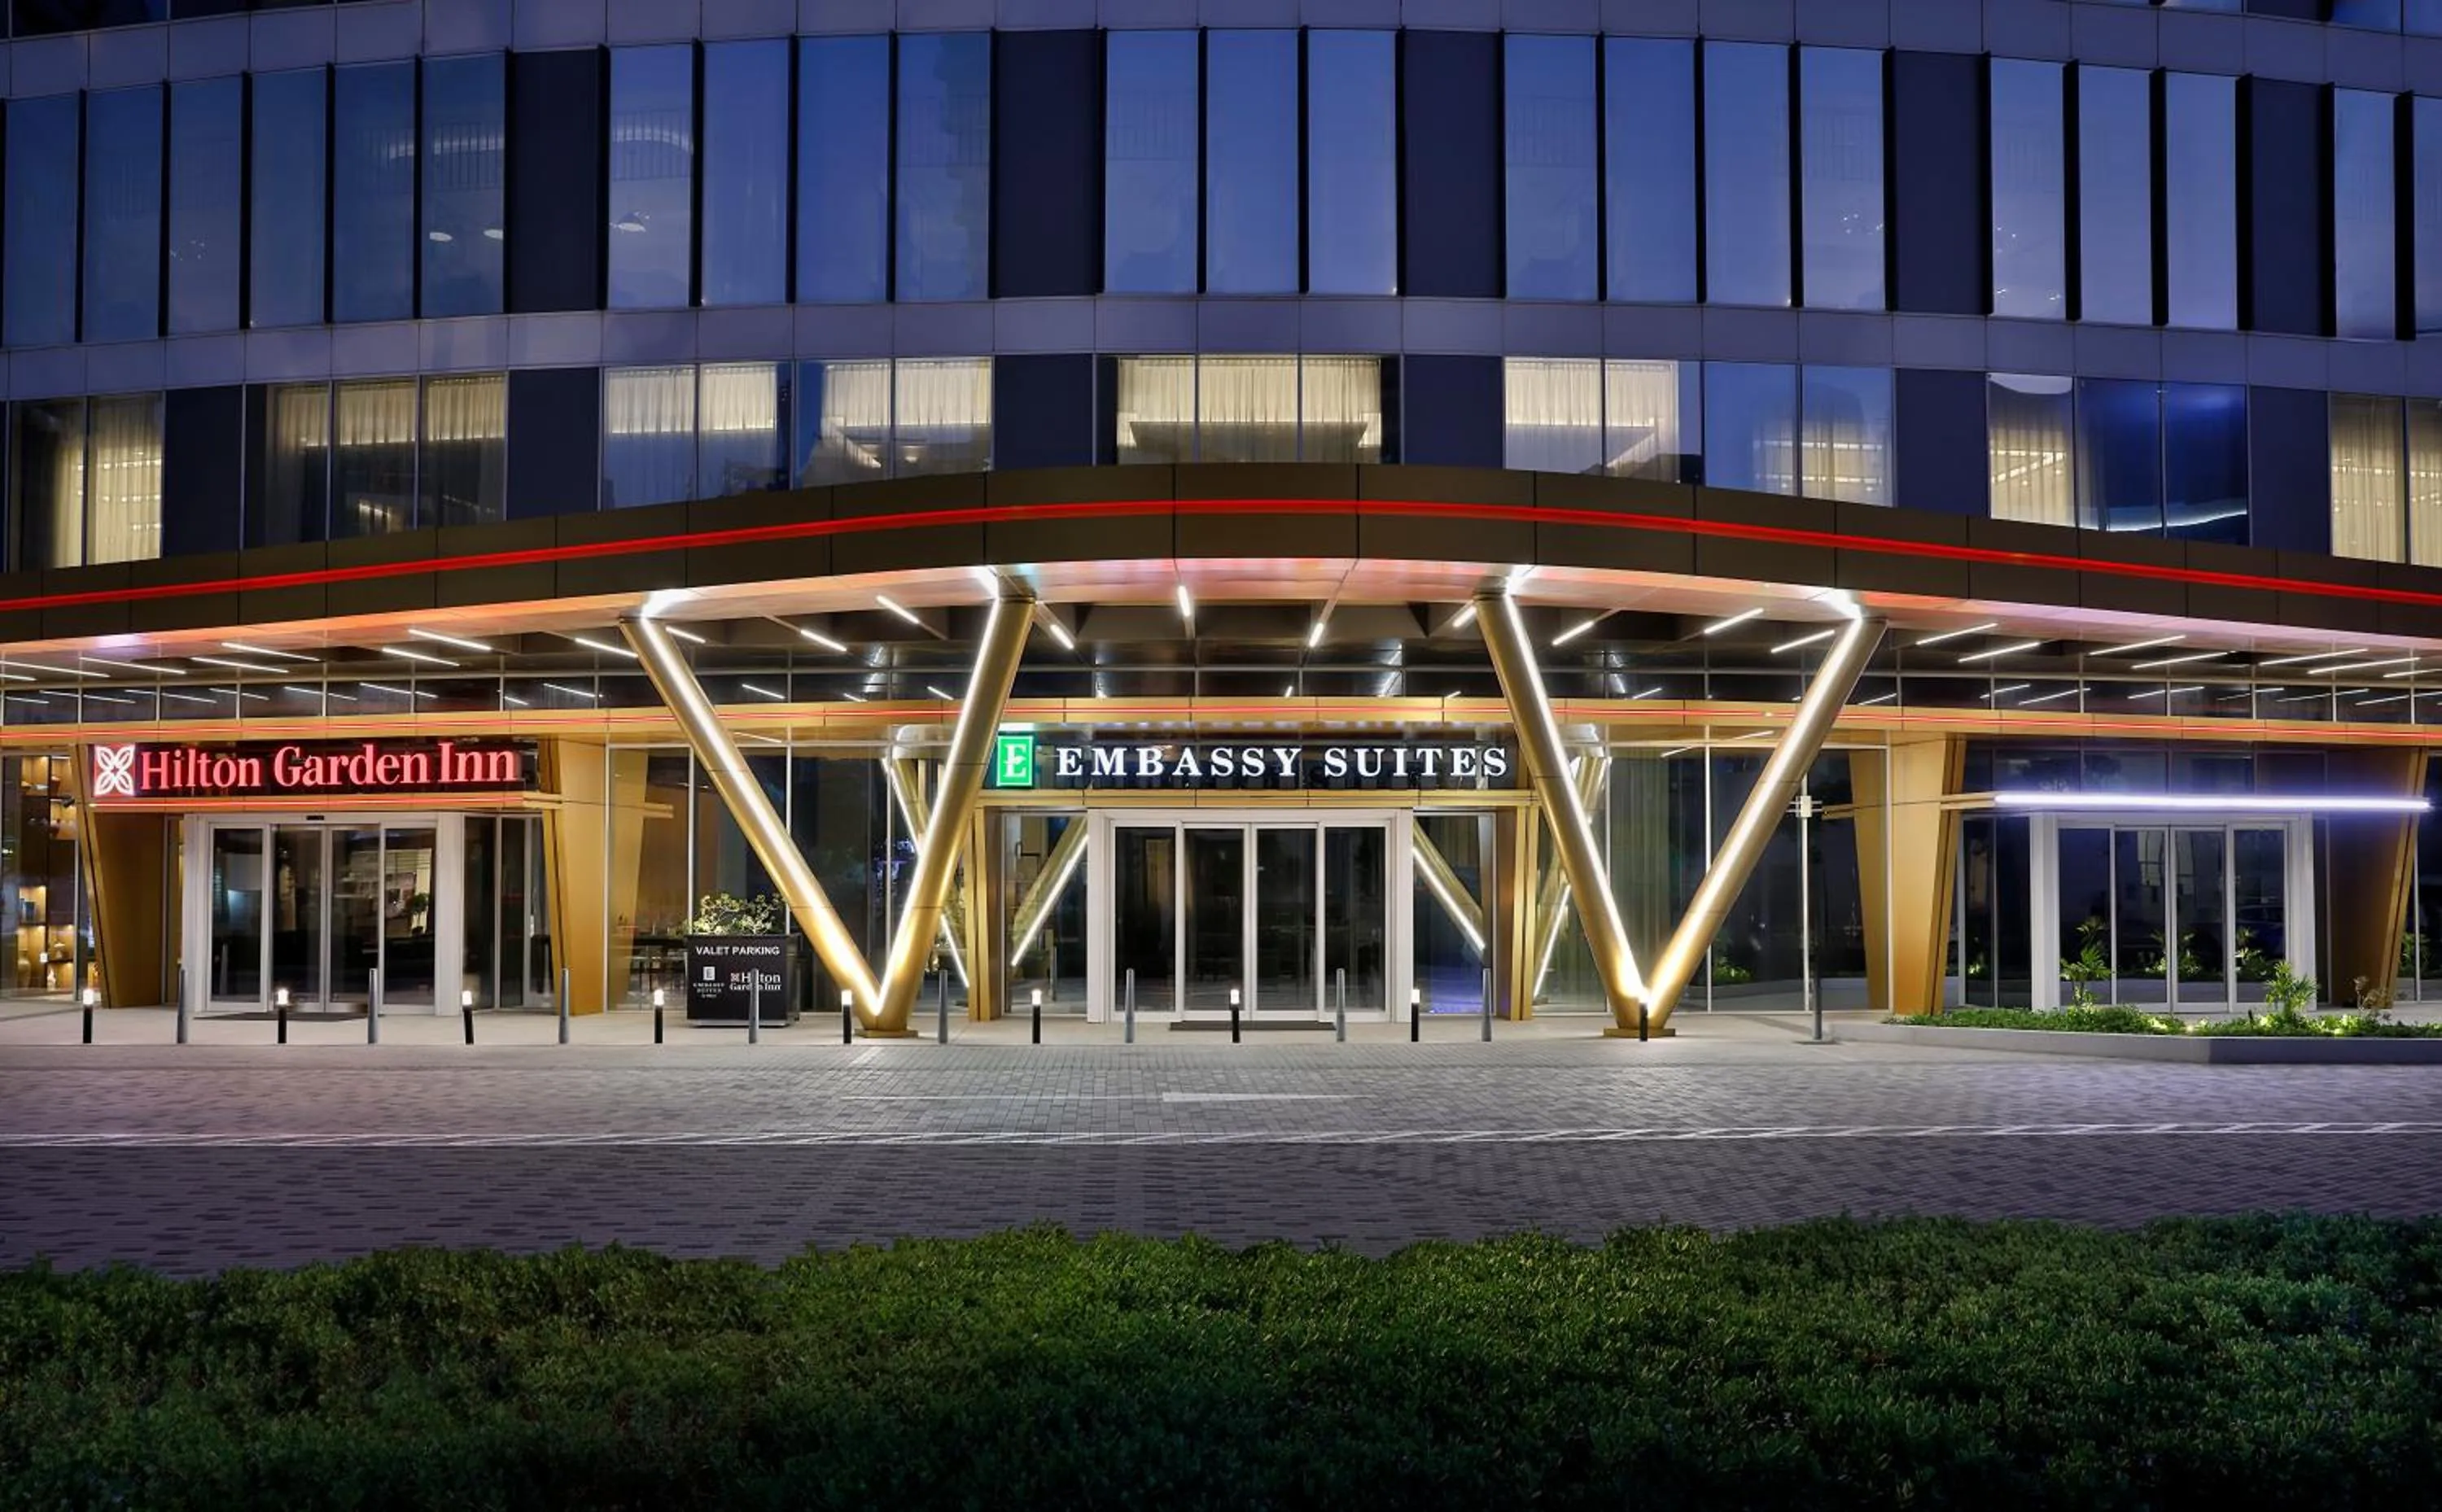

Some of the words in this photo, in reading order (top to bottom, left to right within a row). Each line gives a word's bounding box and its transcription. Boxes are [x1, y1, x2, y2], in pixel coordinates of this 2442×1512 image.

[141, 748, 261, 790] Hilton
[274, 743, 430, 787] Garden
[437, 741, 519, 782] Inn
[1004, 743, 1027, 778] E
[1056, 746, 1302, 777] EMBASSY
[1324, 746, 1508, 778] SUITES
[695, 946, 730, 955] VALET
[733, 946, 781, 956] PARKING
[742, 972, 781, 984] Hton
